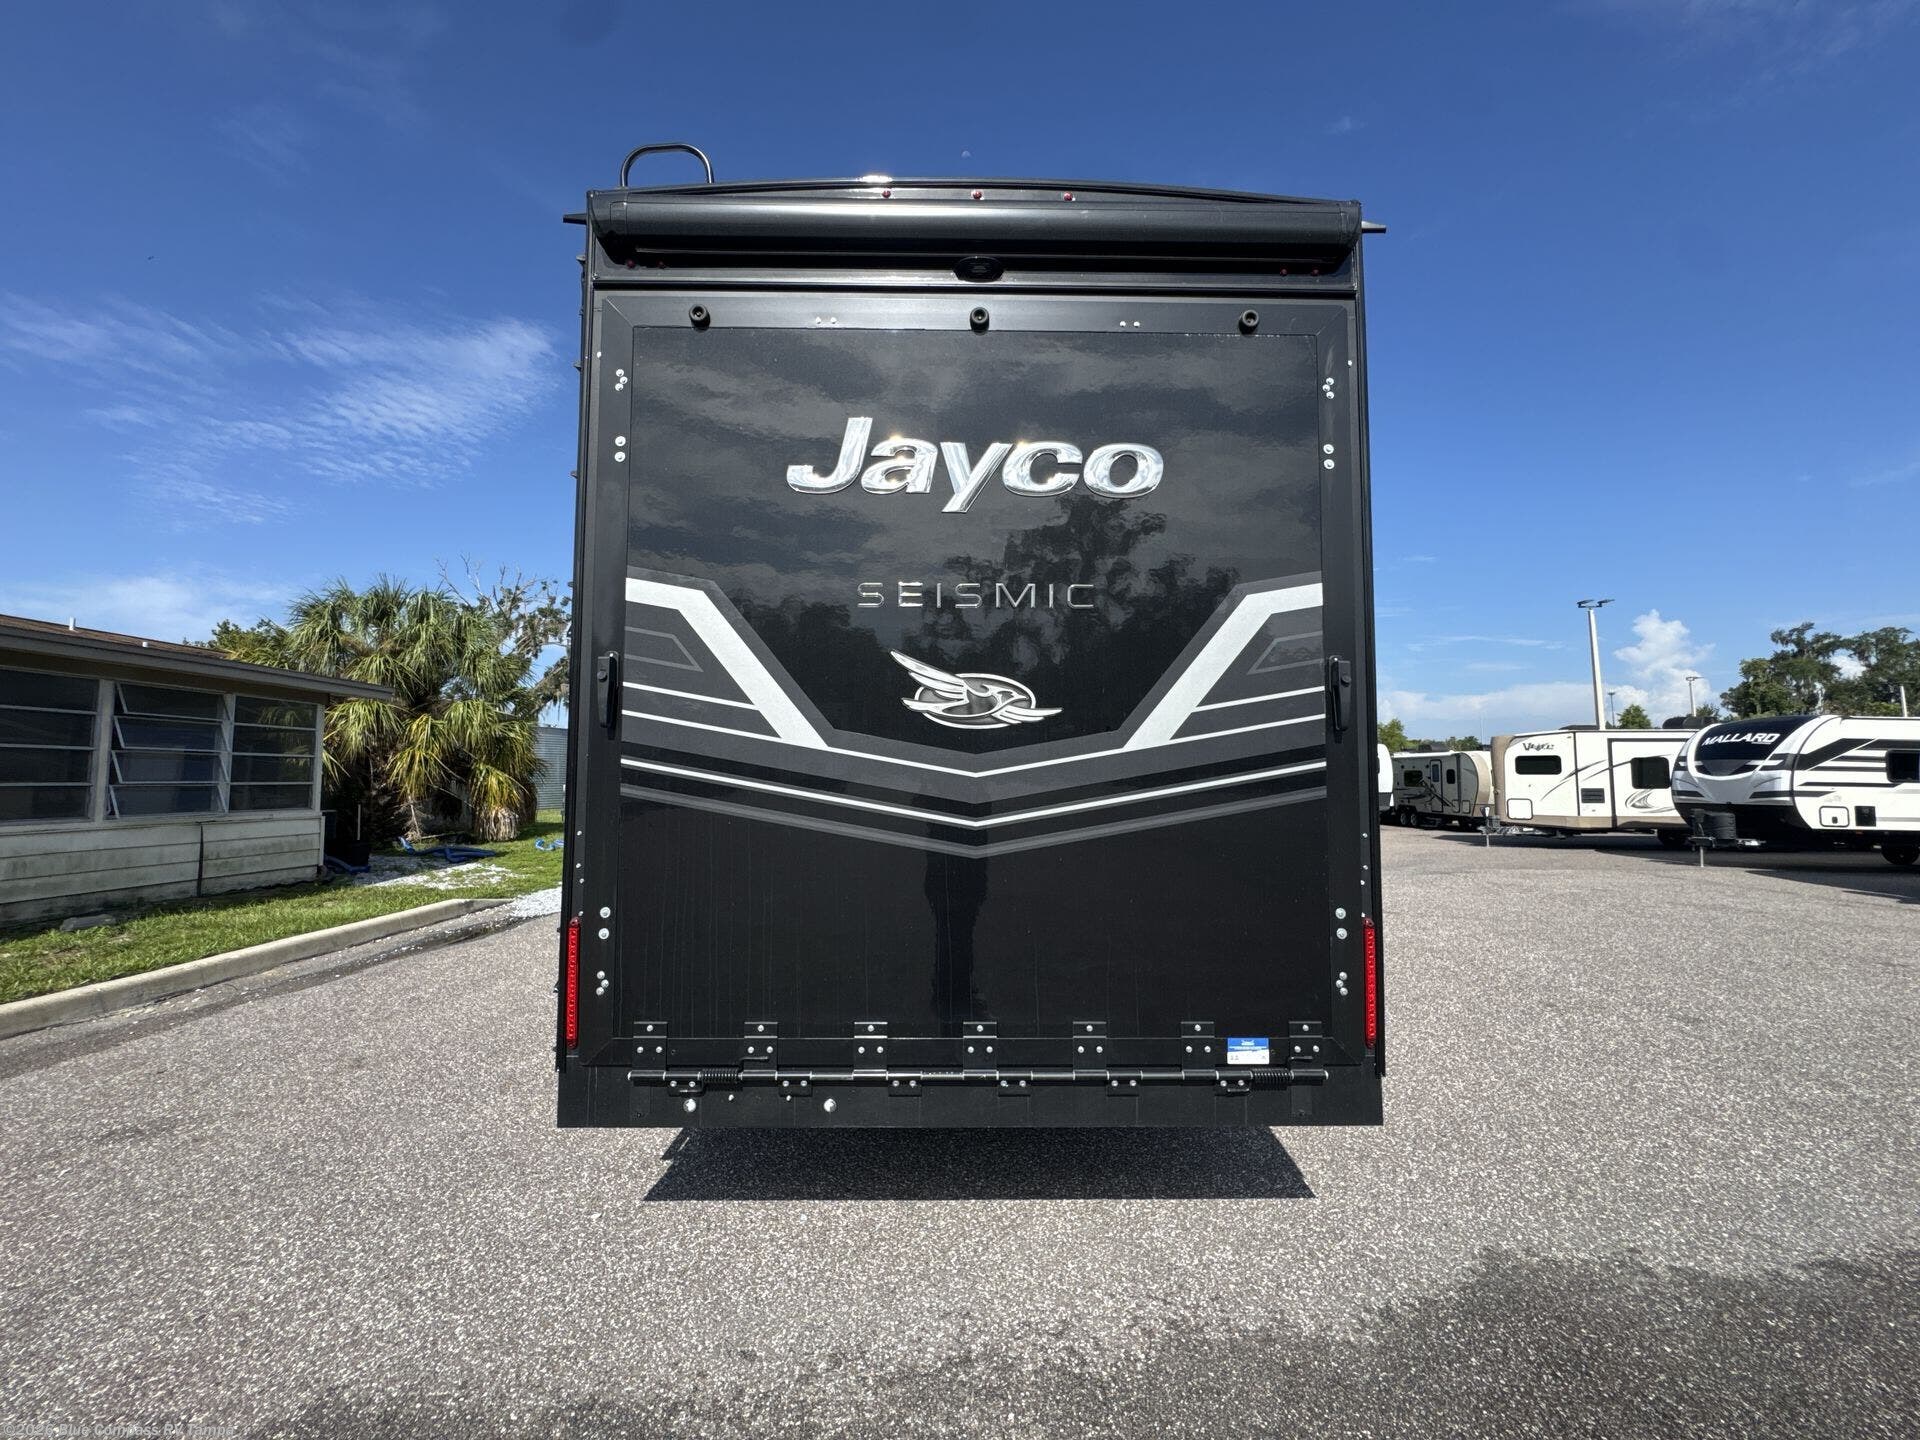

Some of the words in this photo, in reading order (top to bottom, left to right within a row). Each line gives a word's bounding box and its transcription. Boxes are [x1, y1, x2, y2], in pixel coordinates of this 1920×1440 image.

[785, 416, 1164, 513] Jayco
[857, 581, 1095, 609] SEISMIC
[1701, 732, 1781, 746] MALLARD
